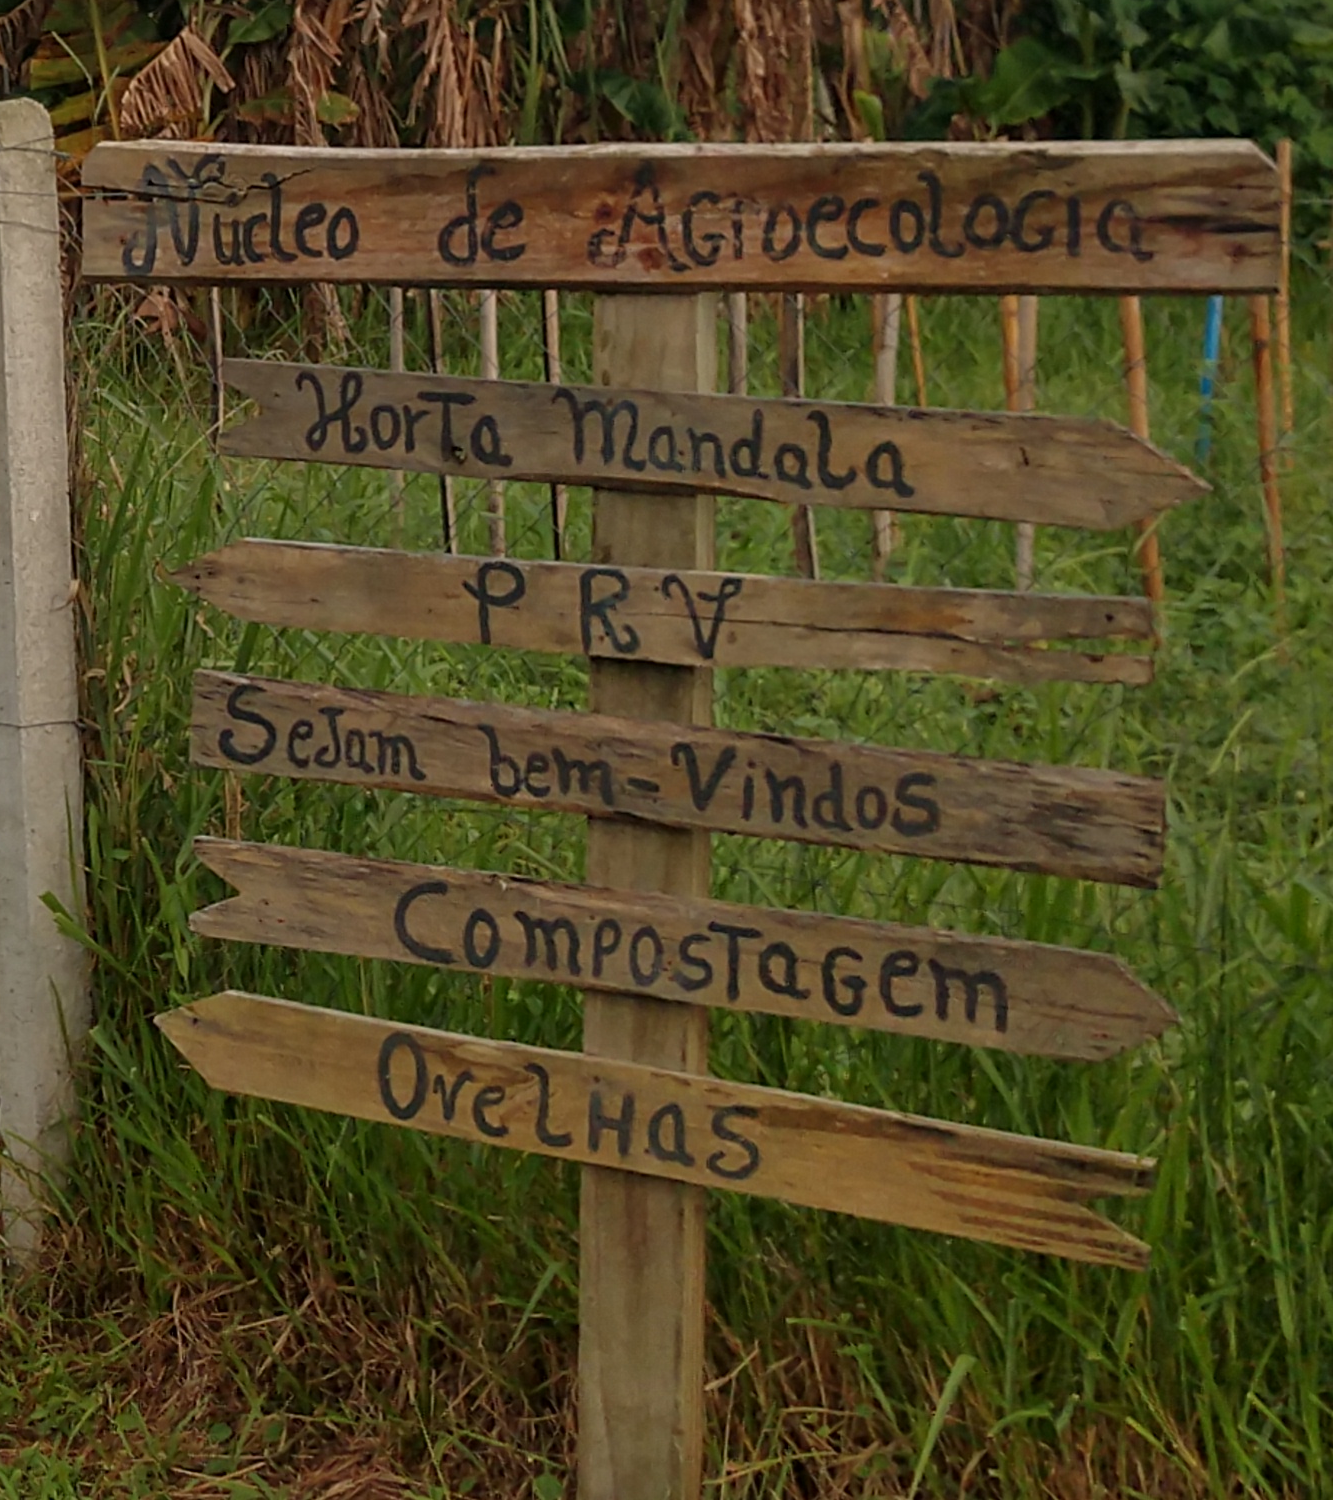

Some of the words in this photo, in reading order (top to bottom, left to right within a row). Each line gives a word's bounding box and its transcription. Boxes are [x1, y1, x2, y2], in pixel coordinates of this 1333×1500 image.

[438, 161, 527, 268] de
[551, 387, 915, 498] Mandala
[462, 560, 526, 645] P
[579, 567, 641, 655] R
[661, 572, 744, 660] V
